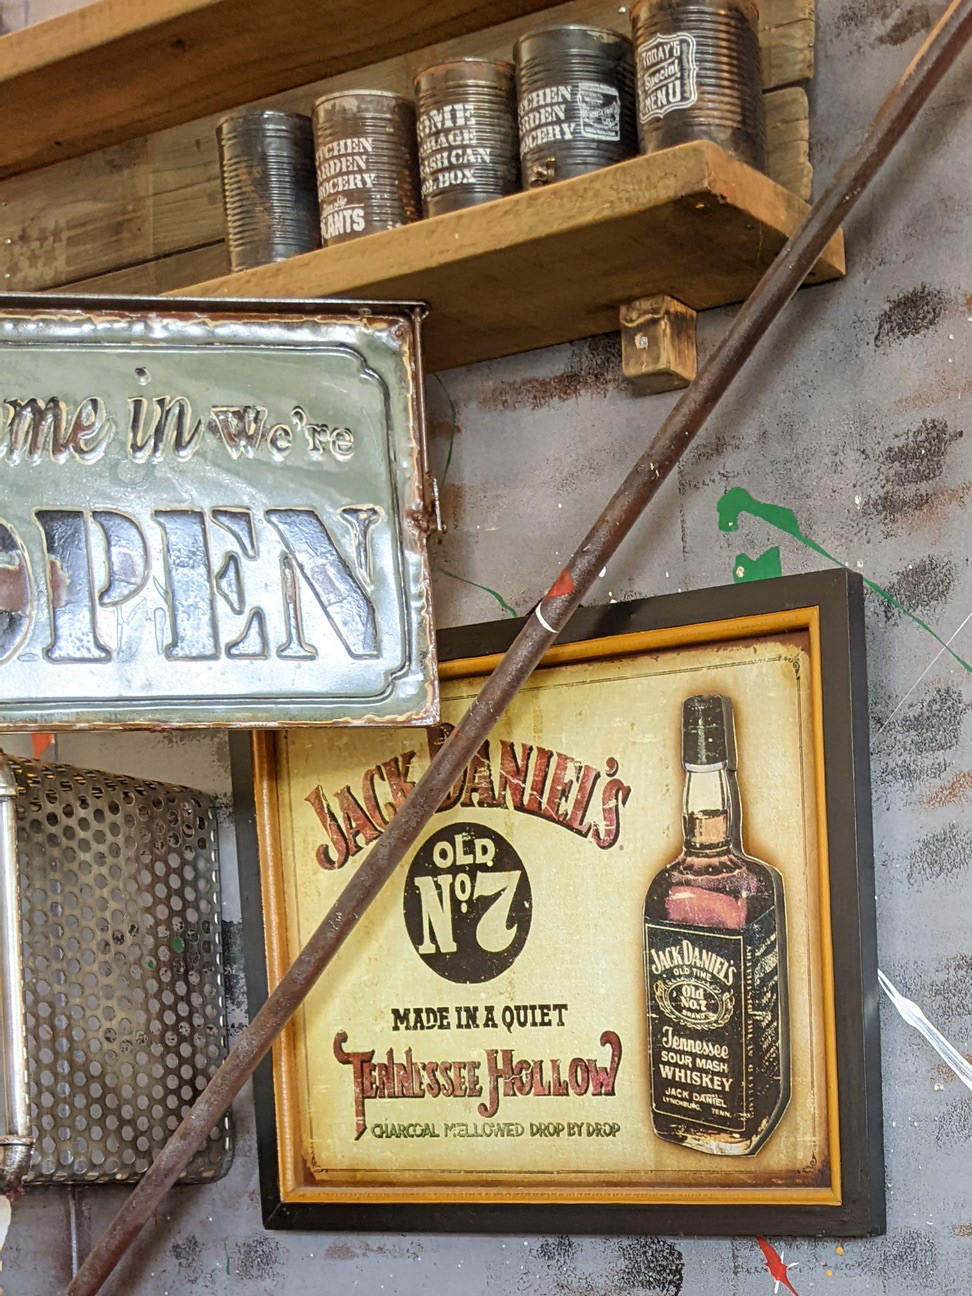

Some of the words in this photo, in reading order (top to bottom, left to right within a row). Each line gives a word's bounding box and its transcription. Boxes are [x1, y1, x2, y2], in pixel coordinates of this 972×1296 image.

[126, 366, 202, 464] in
[391, 1007, 452, 1031] MADE
[455, 1006, 479, 1030] IN
[482, 1005, 500, 1029] A
[501, 1003, 569, 1033] QUIET
[662, 1025, 729, 1060] Tennessee
[661, 1050, 693, 1069] SOUR
[695, 1057, 729, 1075] MASH
[658, 1063, 734, 1092] WHISKEY
[665, 1086, 690, 1100] JACK
[371, 1122, 440, 1139] CHARCOAL
[529, 1122, 565, 1138] DROP
[566, 1122, 584, 1138] BY
[585, 1123, 622, 1138] DROP
